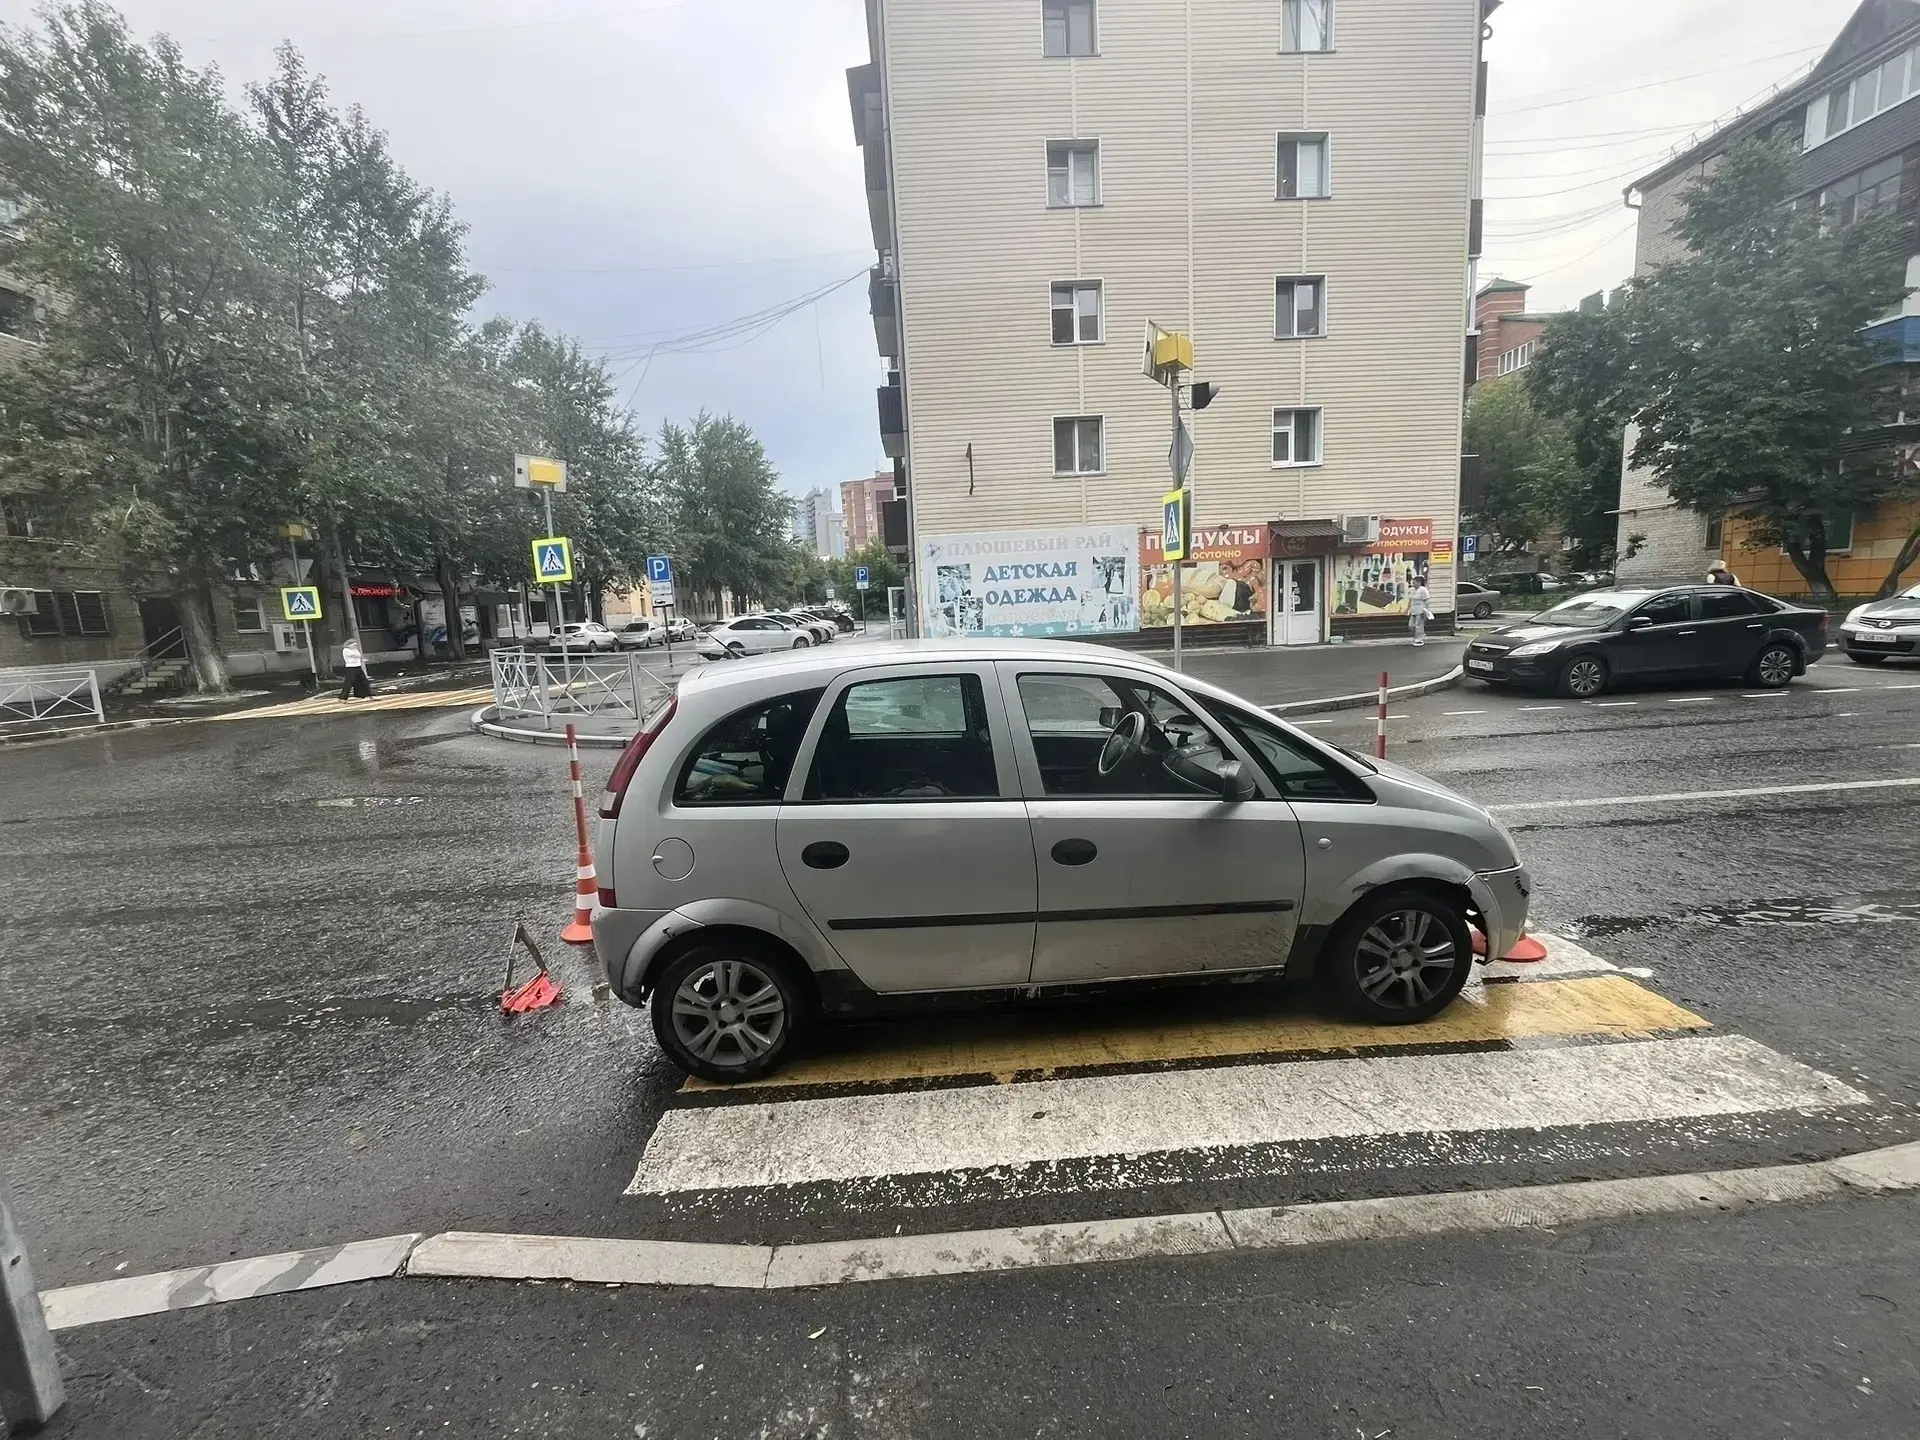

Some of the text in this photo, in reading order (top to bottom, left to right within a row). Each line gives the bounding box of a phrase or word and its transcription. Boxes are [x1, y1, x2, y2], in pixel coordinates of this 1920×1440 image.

[1146, 528, 1260, 550] ПДУКТЫ
[1379, 525, 1429, 537] ОДУКТЫ
[947, 532, 1112, 556] ПЛЮШЕВЫЙ РАЙ
[1367, 539, 1429, 548] УГЛОСУТОЧНО
[1191, 549, 1242, 560] ОСУТОЧНО
[653, 559, 665, 579] P
[982, 561, 1078, 583] ДЕТСКАЯ
[985, 586, 1078, 607] ОДЕЖДА
